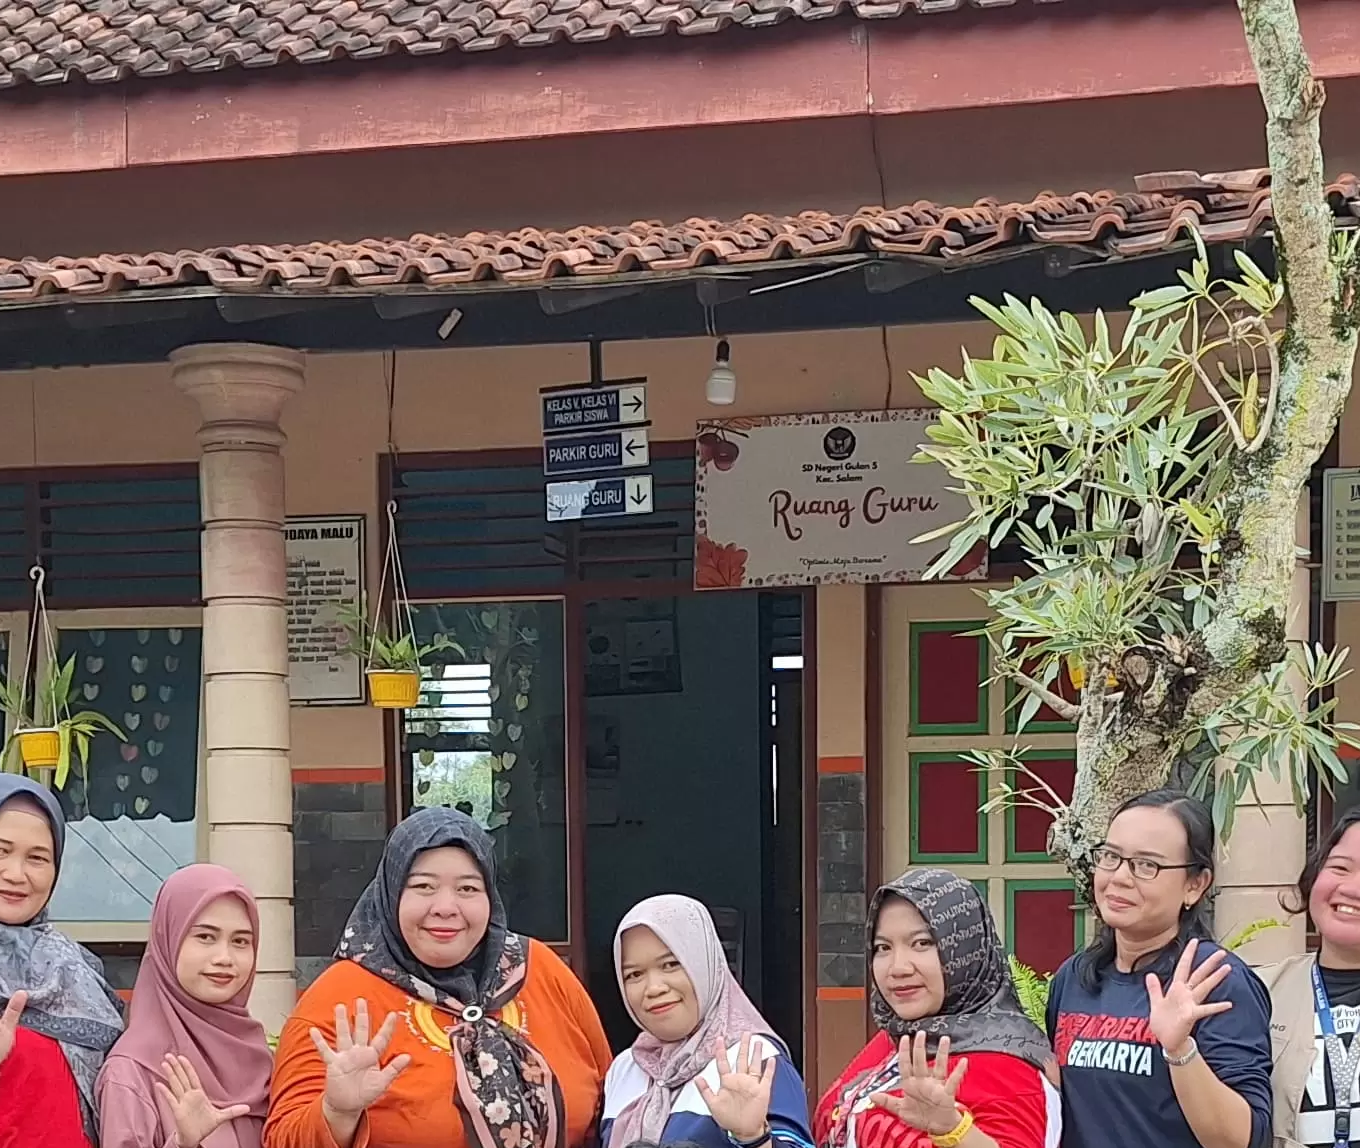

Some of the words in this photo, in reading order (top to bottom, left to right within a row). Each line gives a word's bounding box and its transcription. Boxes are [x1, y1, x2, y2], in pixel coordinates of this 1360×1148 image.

[546, 399, 572, 412] KELAS
[581, 395, 607, 408] KELAS
[607, 393, 617, 405] VI
[554, 411, 583, 425] PARKIR
[583, 408, 610, 423] SISWA
[549, 444, 587, 463] PARKIR
[588, 442, 620, 459] GURU
[801, 464, 813, 472] SD
[815, 463, 843, 473] Negeri
[836, 473, 863, 482] Salam
[553, 492, 590, 507] RUANG
[591, 489, 622, 505] GURU
[769, 490, 855, 541] Ruang
[862, 487, 939, 525] Guru
[320, 527, 353, 539] MALU
[1337, 1019, 1356, 1029] CITY
[1068, 1040, 1152, 1076] BERKARYA
